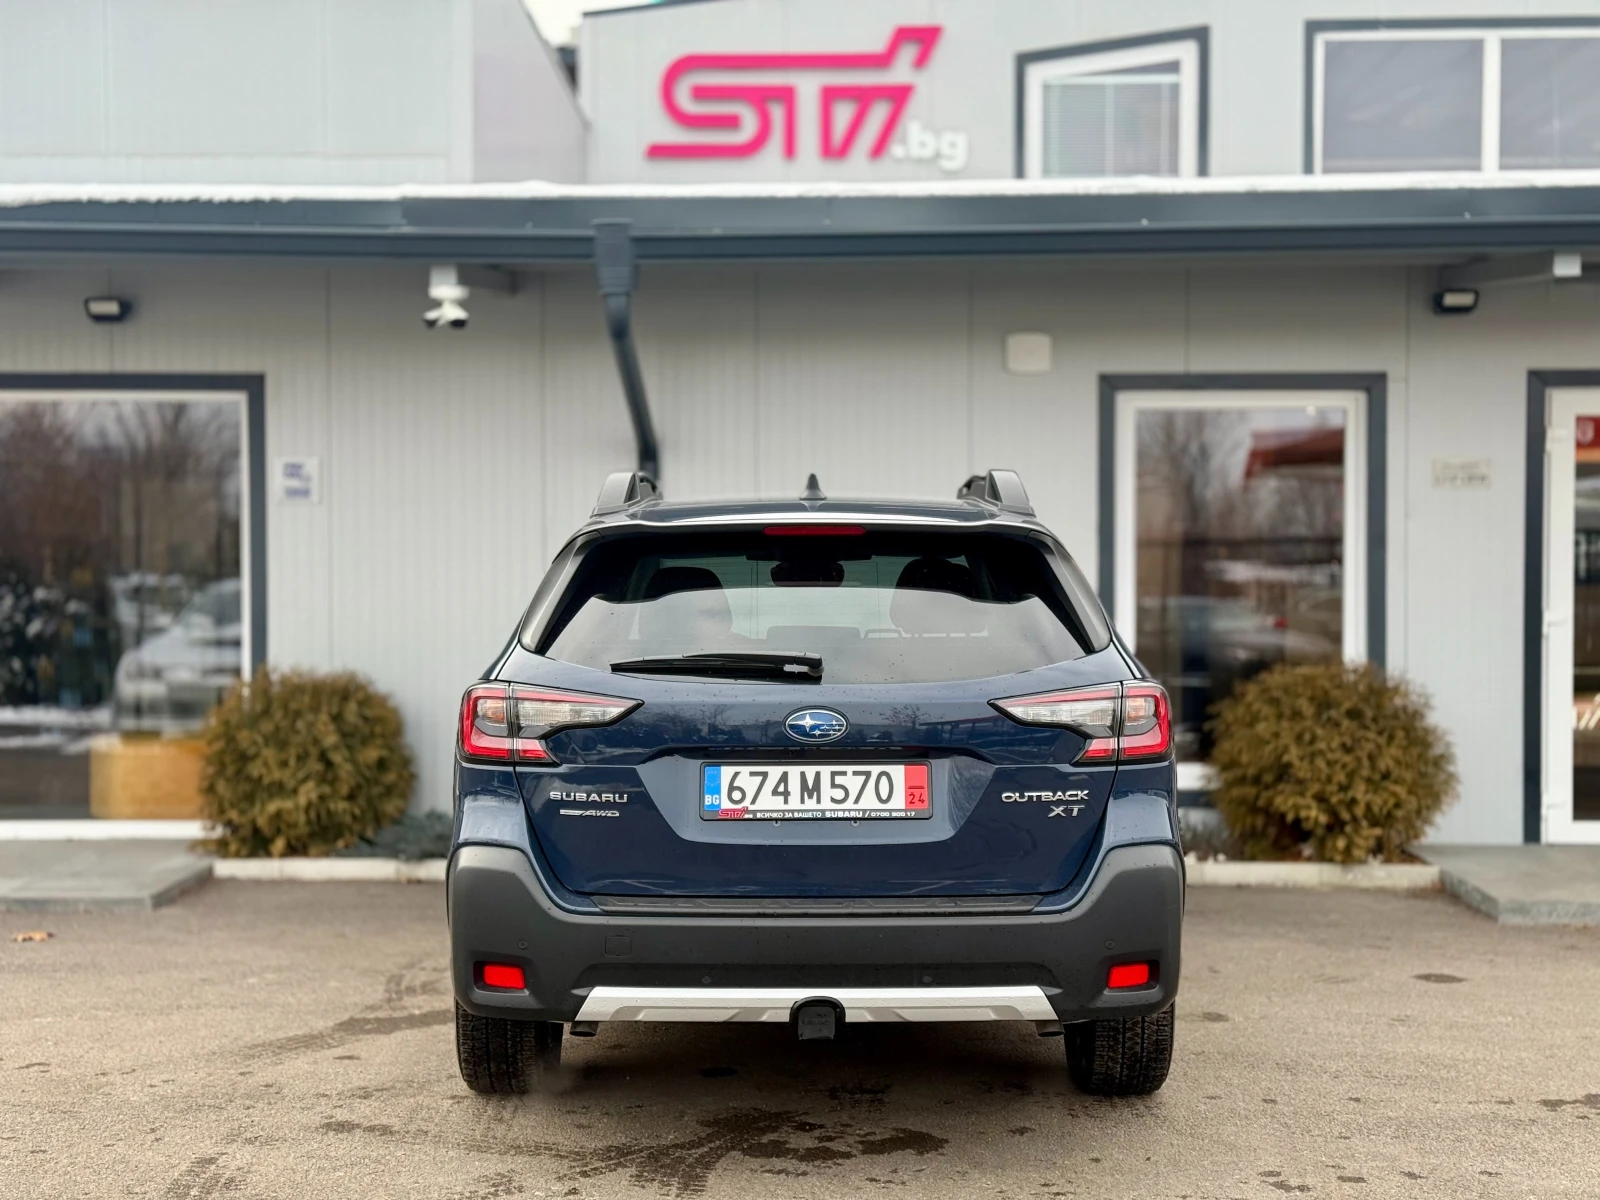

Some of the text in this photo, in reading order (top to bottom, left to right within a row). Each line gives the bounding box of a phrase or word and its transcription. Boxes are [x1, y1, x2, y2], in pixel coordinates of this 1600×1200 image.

[549, 791, 628, 803] SUBARU
[705, 795, 720, 805] BG
[909, 792, 925, 804] 24
[1001, 790, 1090, 802] OUTBACK
[825, 810, 863, 818] SUBARU
[1047, 805, 1085, 817] XT
